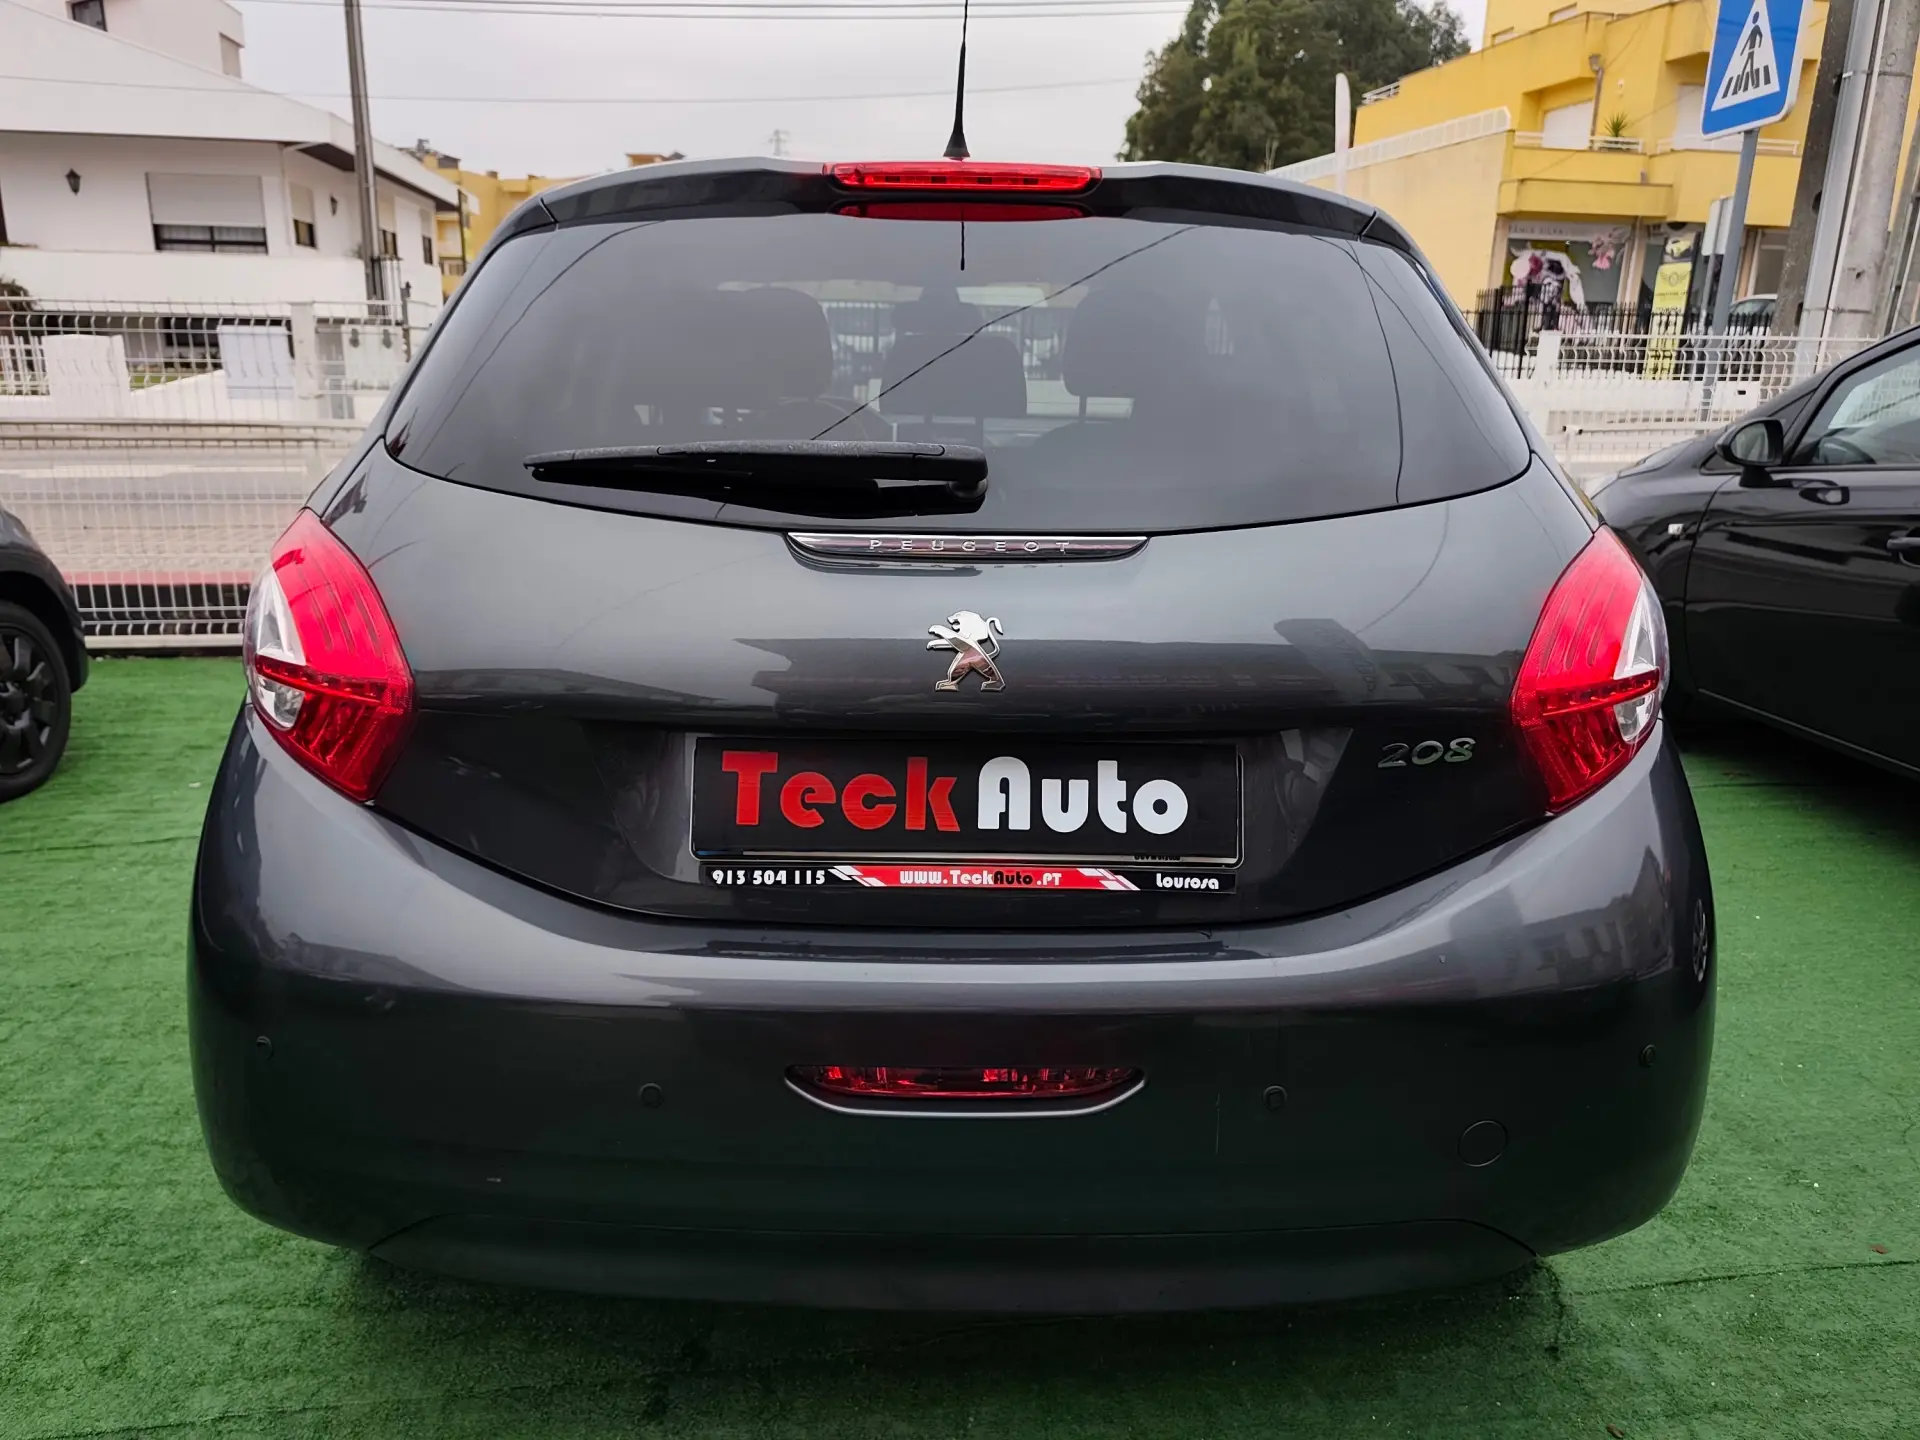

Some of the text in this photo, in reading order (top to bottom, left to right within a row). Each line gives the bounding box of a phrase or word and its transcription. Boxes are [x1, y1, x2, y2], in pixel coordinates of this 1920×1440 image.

[868, 539, 1070, 552] PEUGEOT
[1377, 737, 1477, 768] 208
[721, 750, 1189, 835] Teck Auto
[712, 869, 746, 885] 913
[752, 869, 788, 885] 504
[794, 869, 826, 885] 115
[1155, 872, 1220, 890] Lourosa
